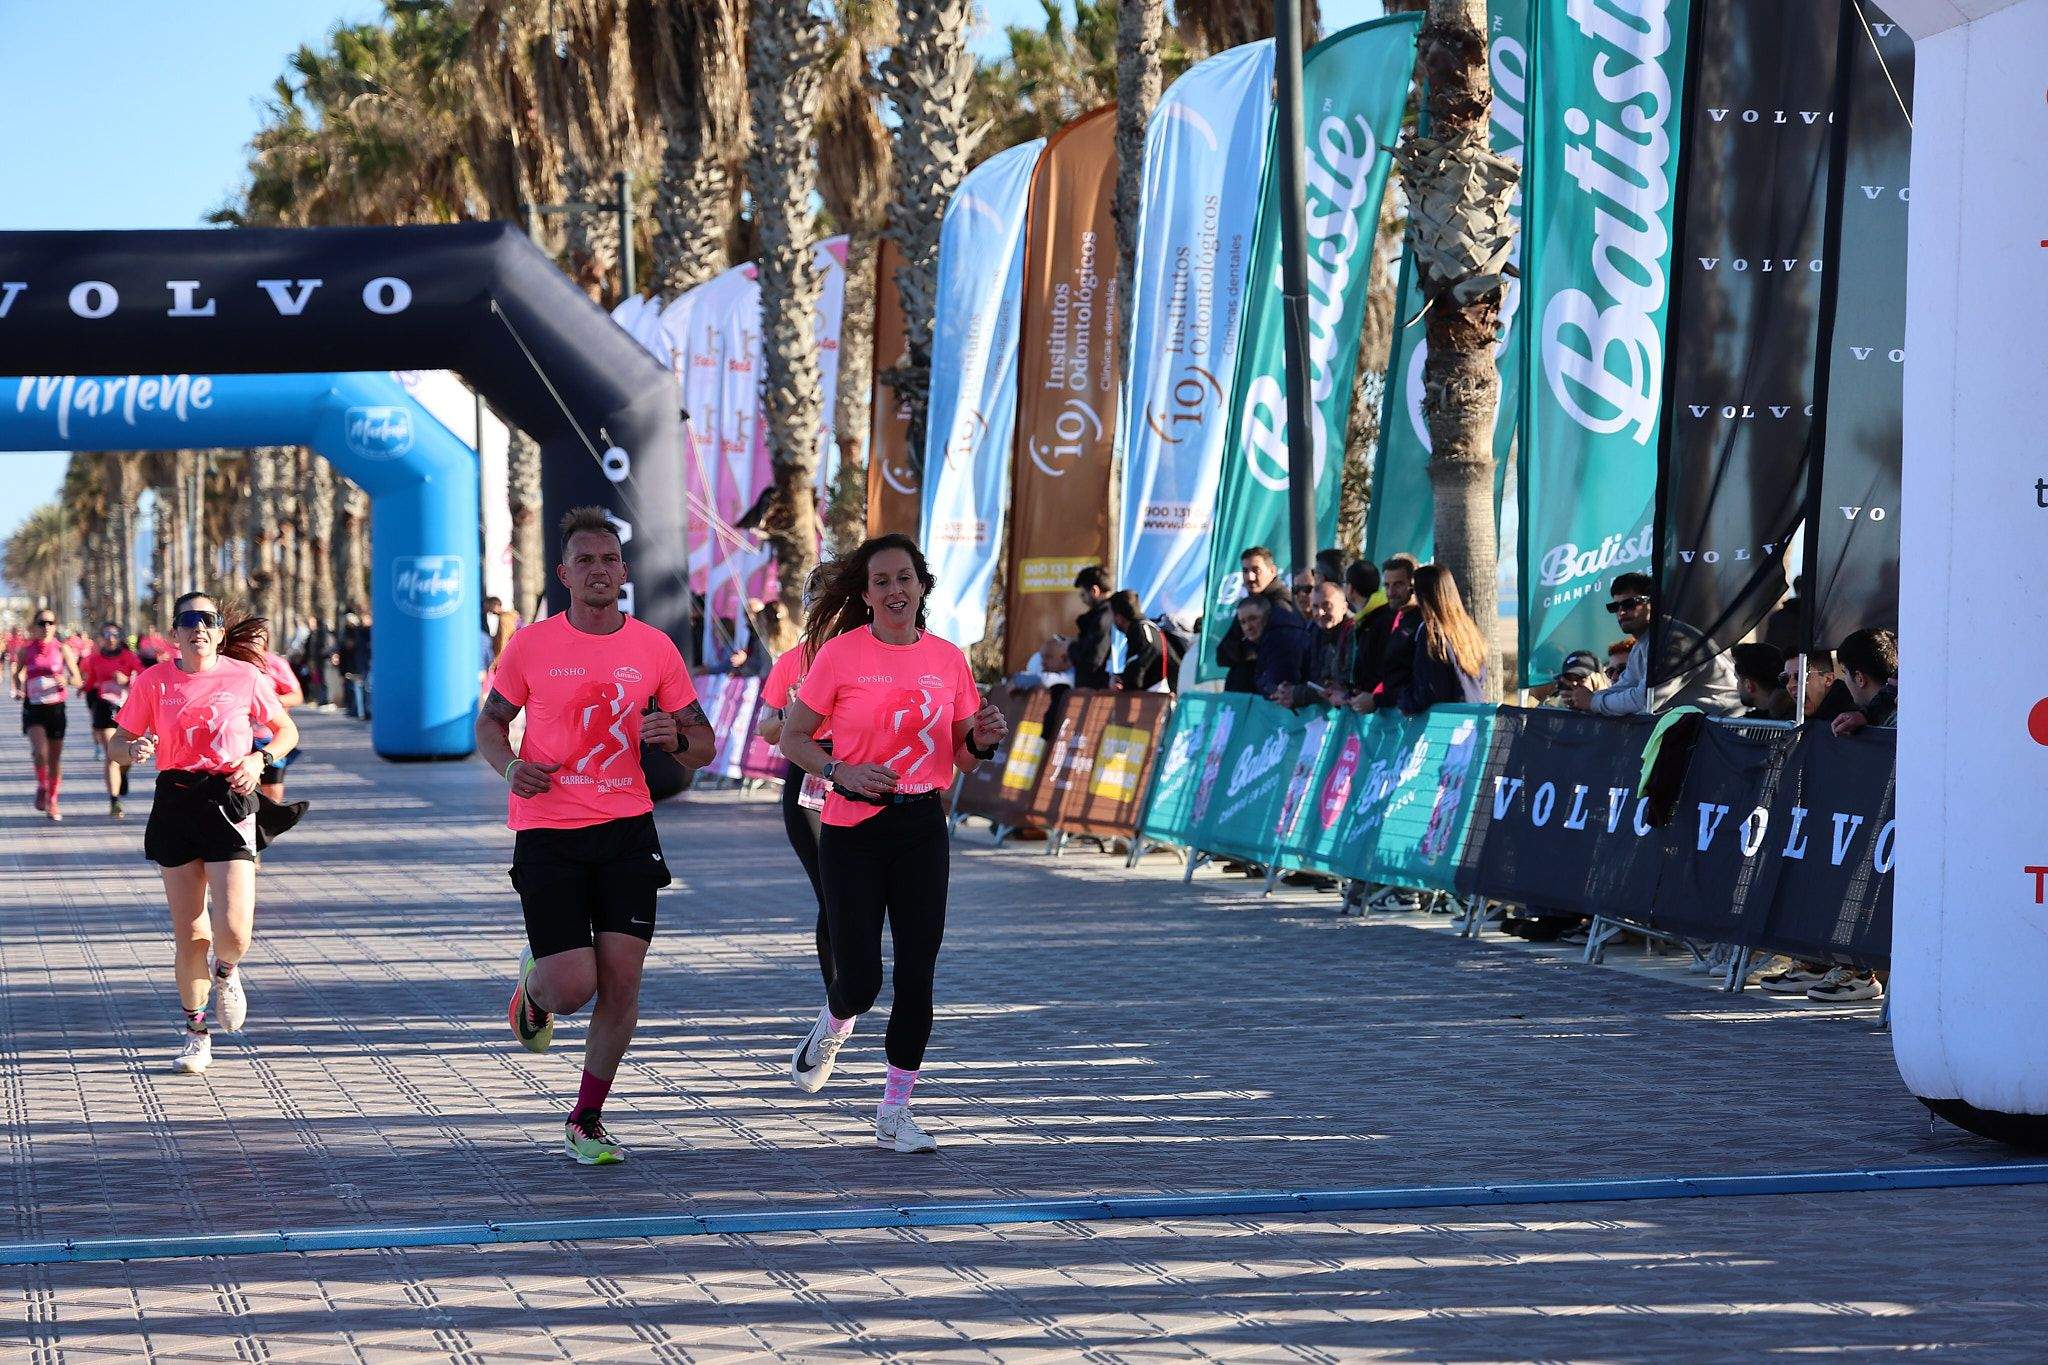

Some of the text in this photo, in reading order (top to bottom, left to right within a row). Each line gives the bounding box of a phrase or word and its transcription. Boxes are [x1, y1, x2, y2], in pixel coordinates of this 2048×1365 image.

[1707, 109, 1833, 124] VOLV
[1541, 0, 1671, 446] Batist
[1190, 195, 1221, 356] Odontológicos
[1229, 234, 1242, 295] dentales
[1068, 231, 1099, 392] Odontológicos
[1166, 246, 1190, 355] Institutos
[1045, 282, 1070, 391] Institutos
[16, 374, 214, 440] Marlene
[1540, 524, 1653, 587] Batist
[1679, 534, 1792, 563] VOLV
[549, 667, 586, 677] OYSHO
[857, 675, 893, 684] OYSHO
[560, 775, 594, 785] CARRERA
